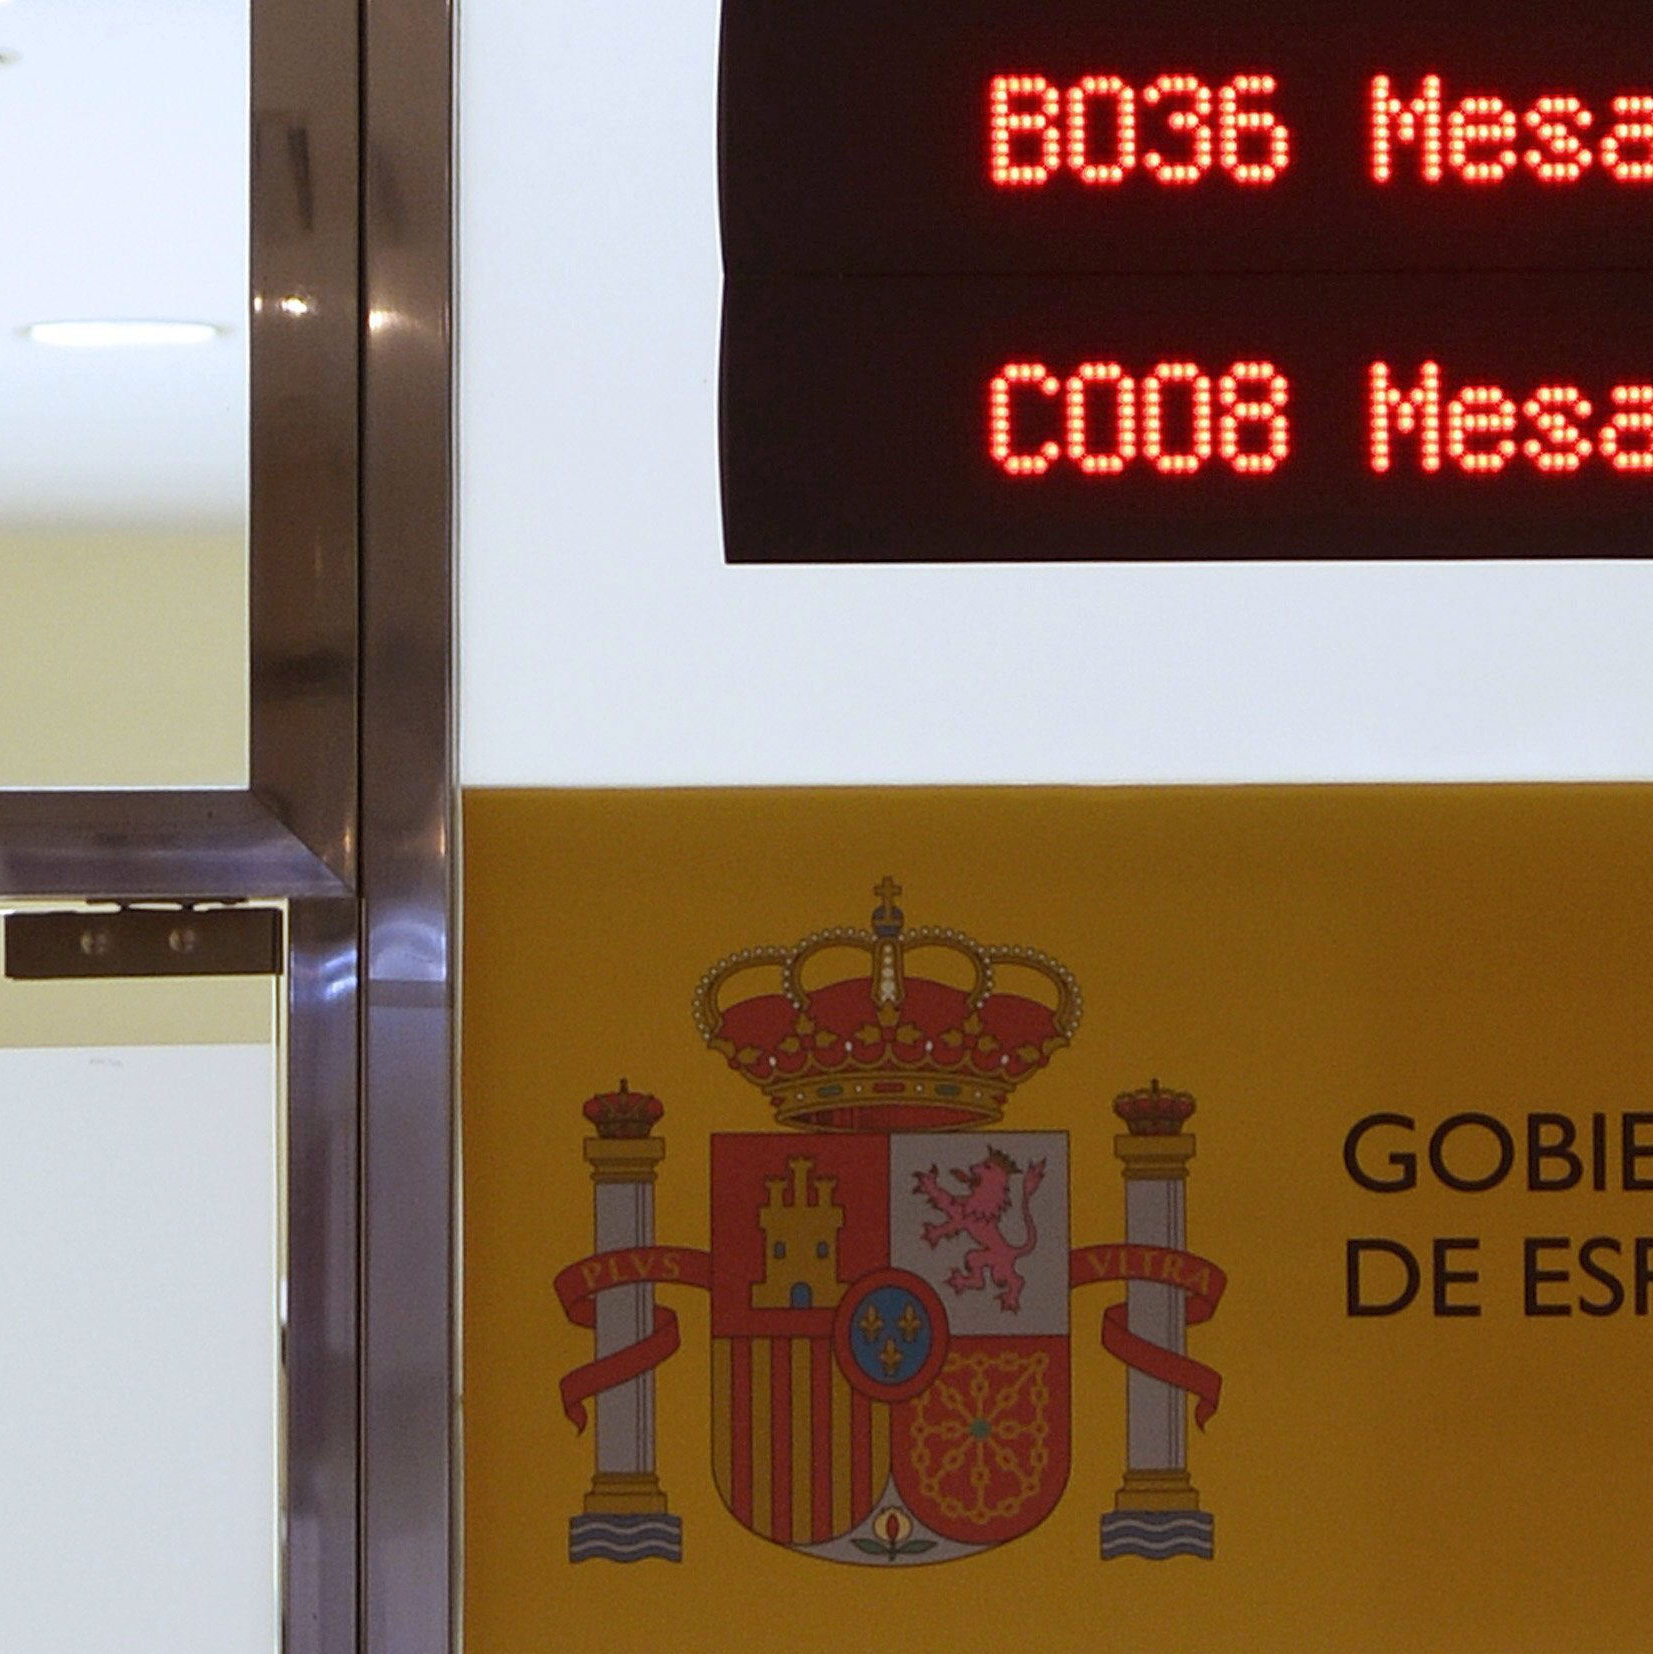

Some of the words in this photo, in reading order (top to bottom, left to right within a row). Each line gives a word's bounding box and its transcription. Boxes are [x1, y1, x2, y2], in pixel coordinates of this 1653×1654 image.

[989, 74, 1290, 186] B036
[989, 361, 1290, 475] C008
[1347, 1239, 1480, 1317] DE
